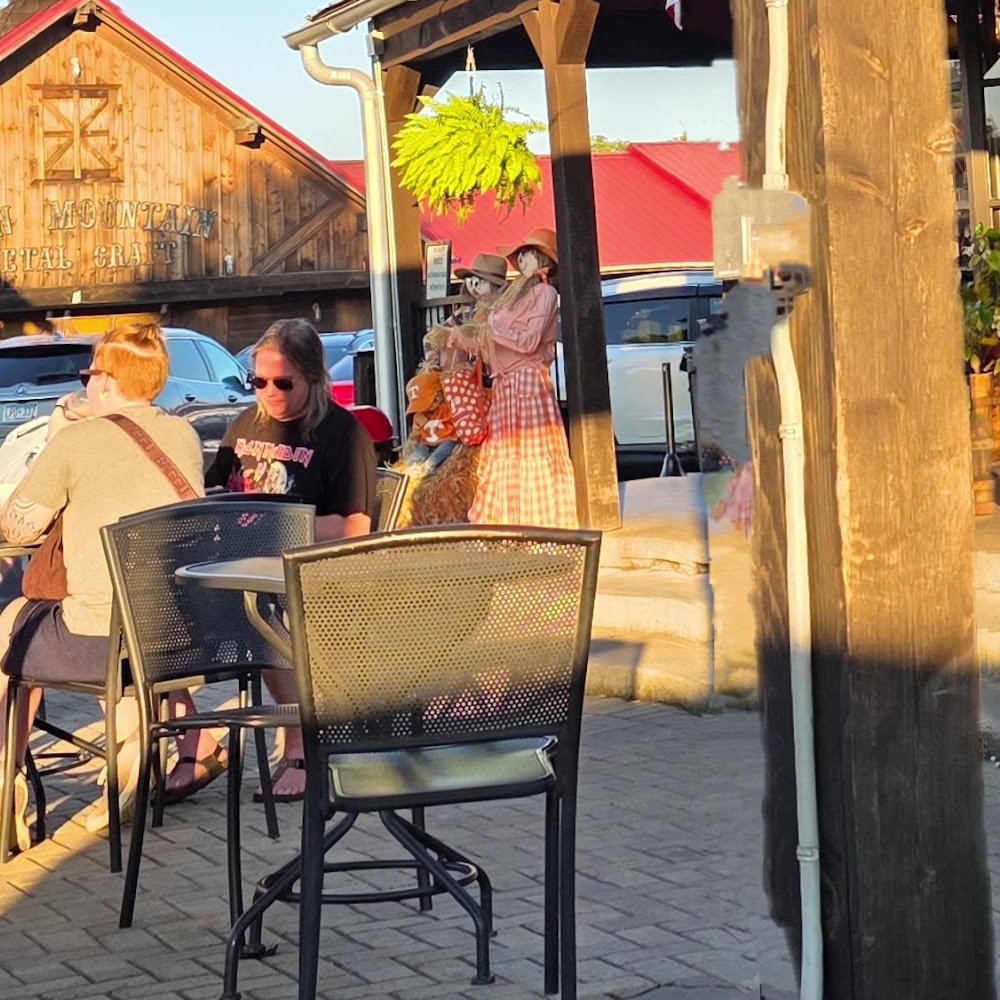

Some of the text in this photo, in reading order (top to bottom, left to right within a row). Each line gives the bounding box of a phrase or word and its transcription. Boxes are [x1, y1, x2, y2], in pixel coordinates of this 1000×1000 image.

[48, 198, 218, 239] MOUNTAIN
[2, 240, 178, 273] ETAL CRAFT
[408, 384, 420, 400] T
[423, 419, 445, 443] T
